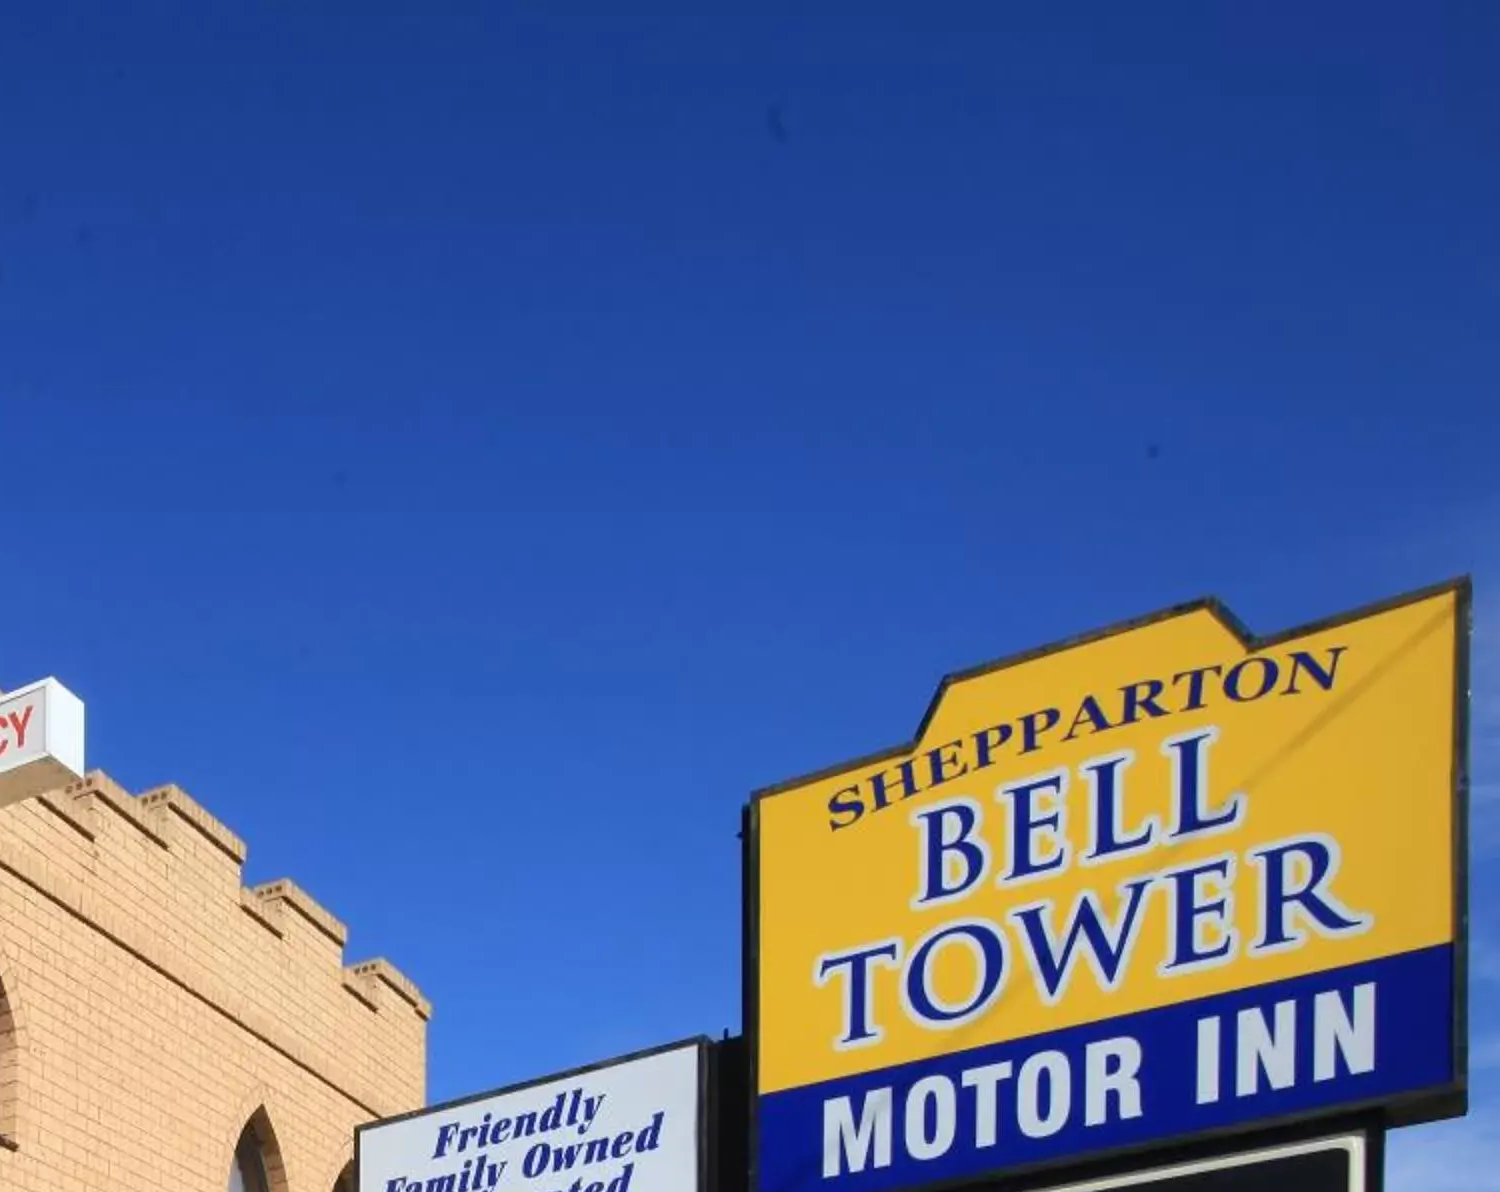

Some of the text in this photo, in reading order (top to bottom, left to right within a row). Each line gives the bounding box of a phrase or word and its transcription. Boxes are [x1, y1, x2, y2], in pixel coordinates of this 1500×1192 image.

[826, 646, 1349, 832] SHEPPARTON
[916, 733, 1241, 904] BELL
[818, 839, 1364, 1044] TOWER
[432, 1088, 606, 1159] Friendly
[521, 1110, 666, 1179] Owned
[821, 981, 1377, 1179] MOTOR INN
